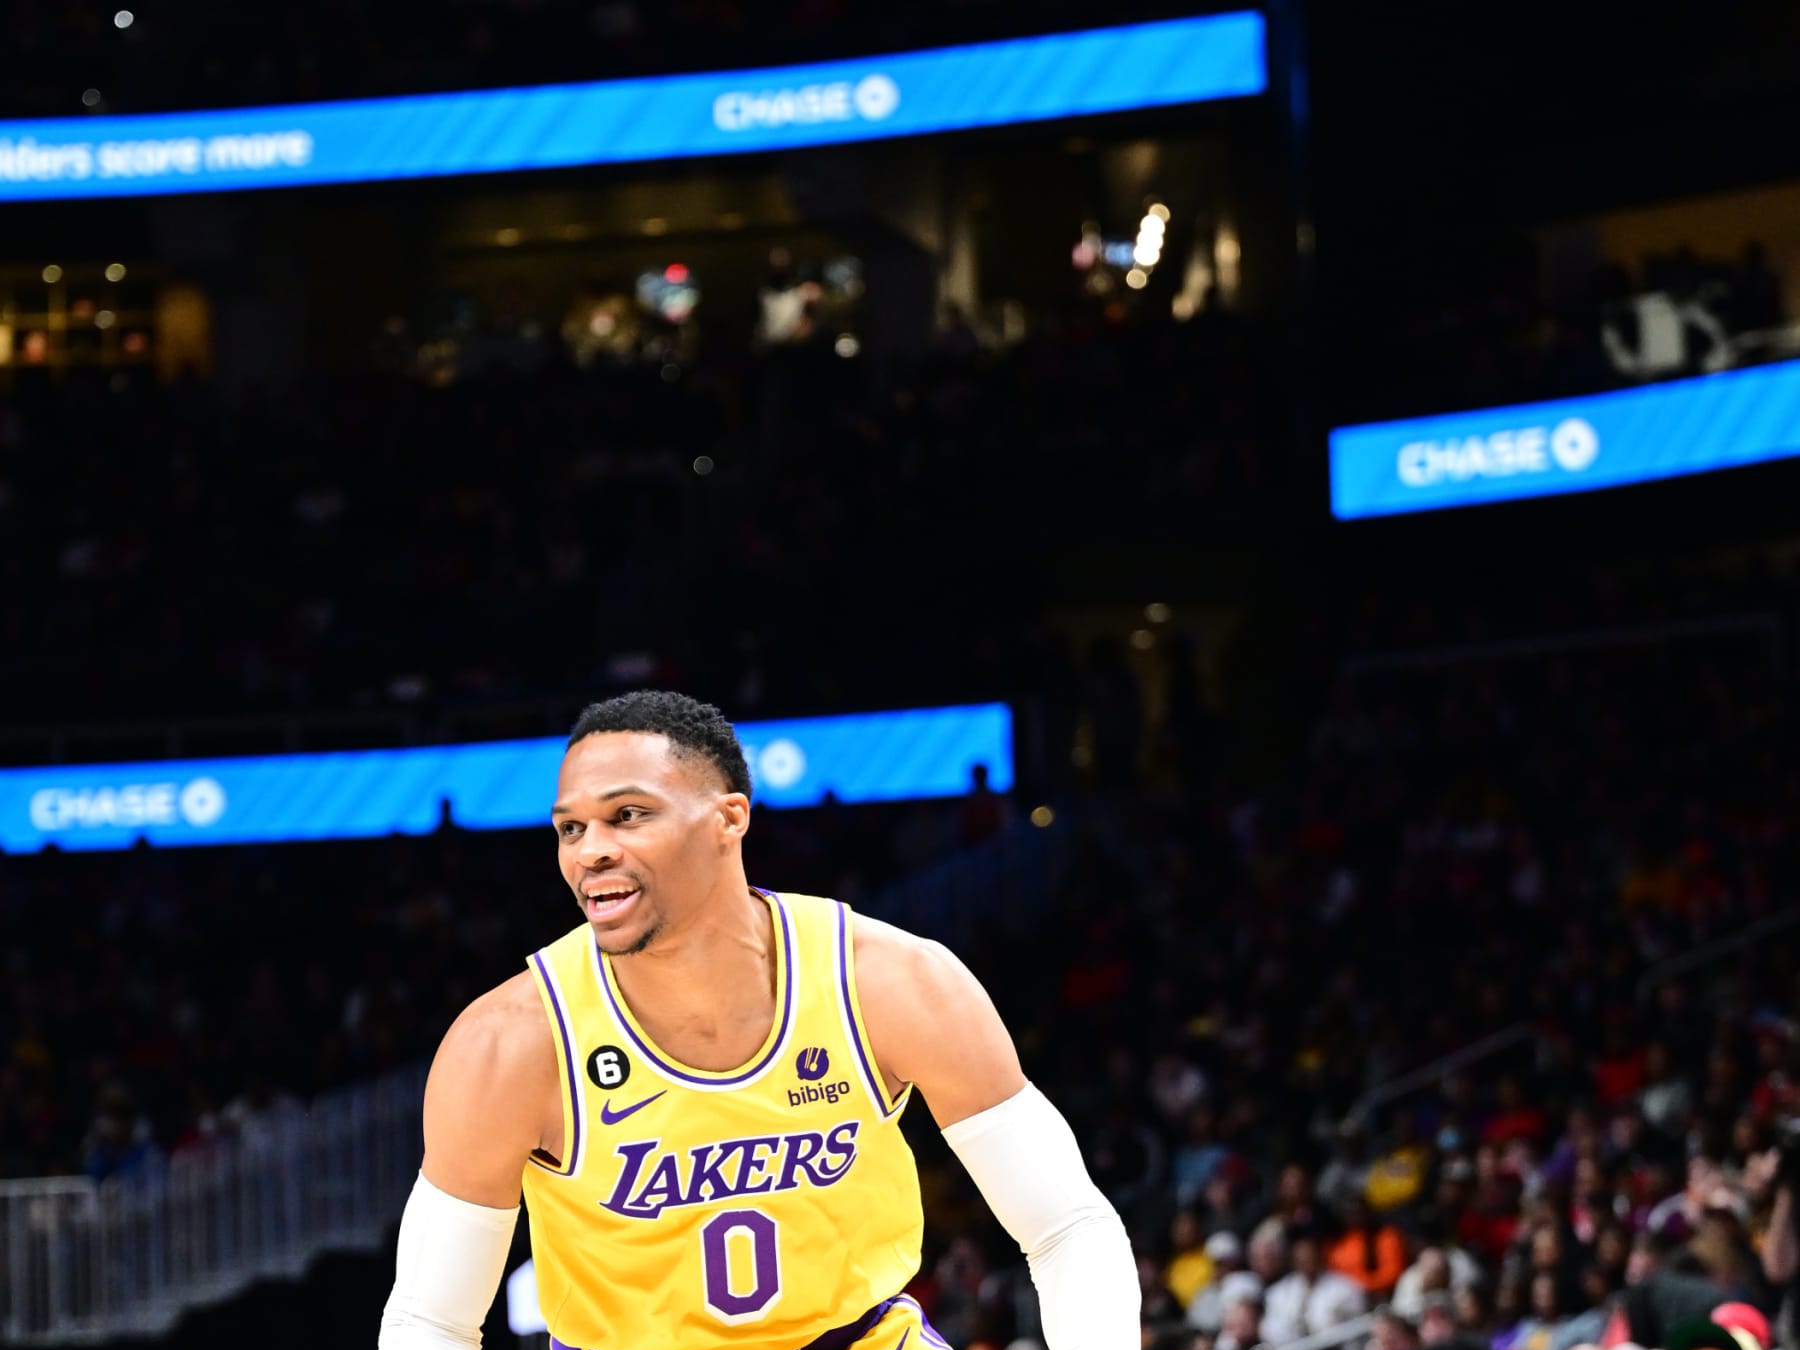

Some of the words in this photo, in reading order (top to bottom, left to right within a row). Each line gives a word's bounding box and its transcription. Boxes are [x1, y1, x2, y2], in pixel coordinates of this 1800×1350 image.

[713, 81, 852, 131] CHASE
[98, 137, 200, 178] score
[205, 130, 314, 171] more
[1397, 425, 1547, 486] CHASE
[30, 782, 177, 831] CHASE
[595, 1050, 623, 1085] 6
[787, 1080, 850, 1107] bibigo
[597, 1120, 862, 1220] LAKERS
[701, 1208, 783, 1327] 0
